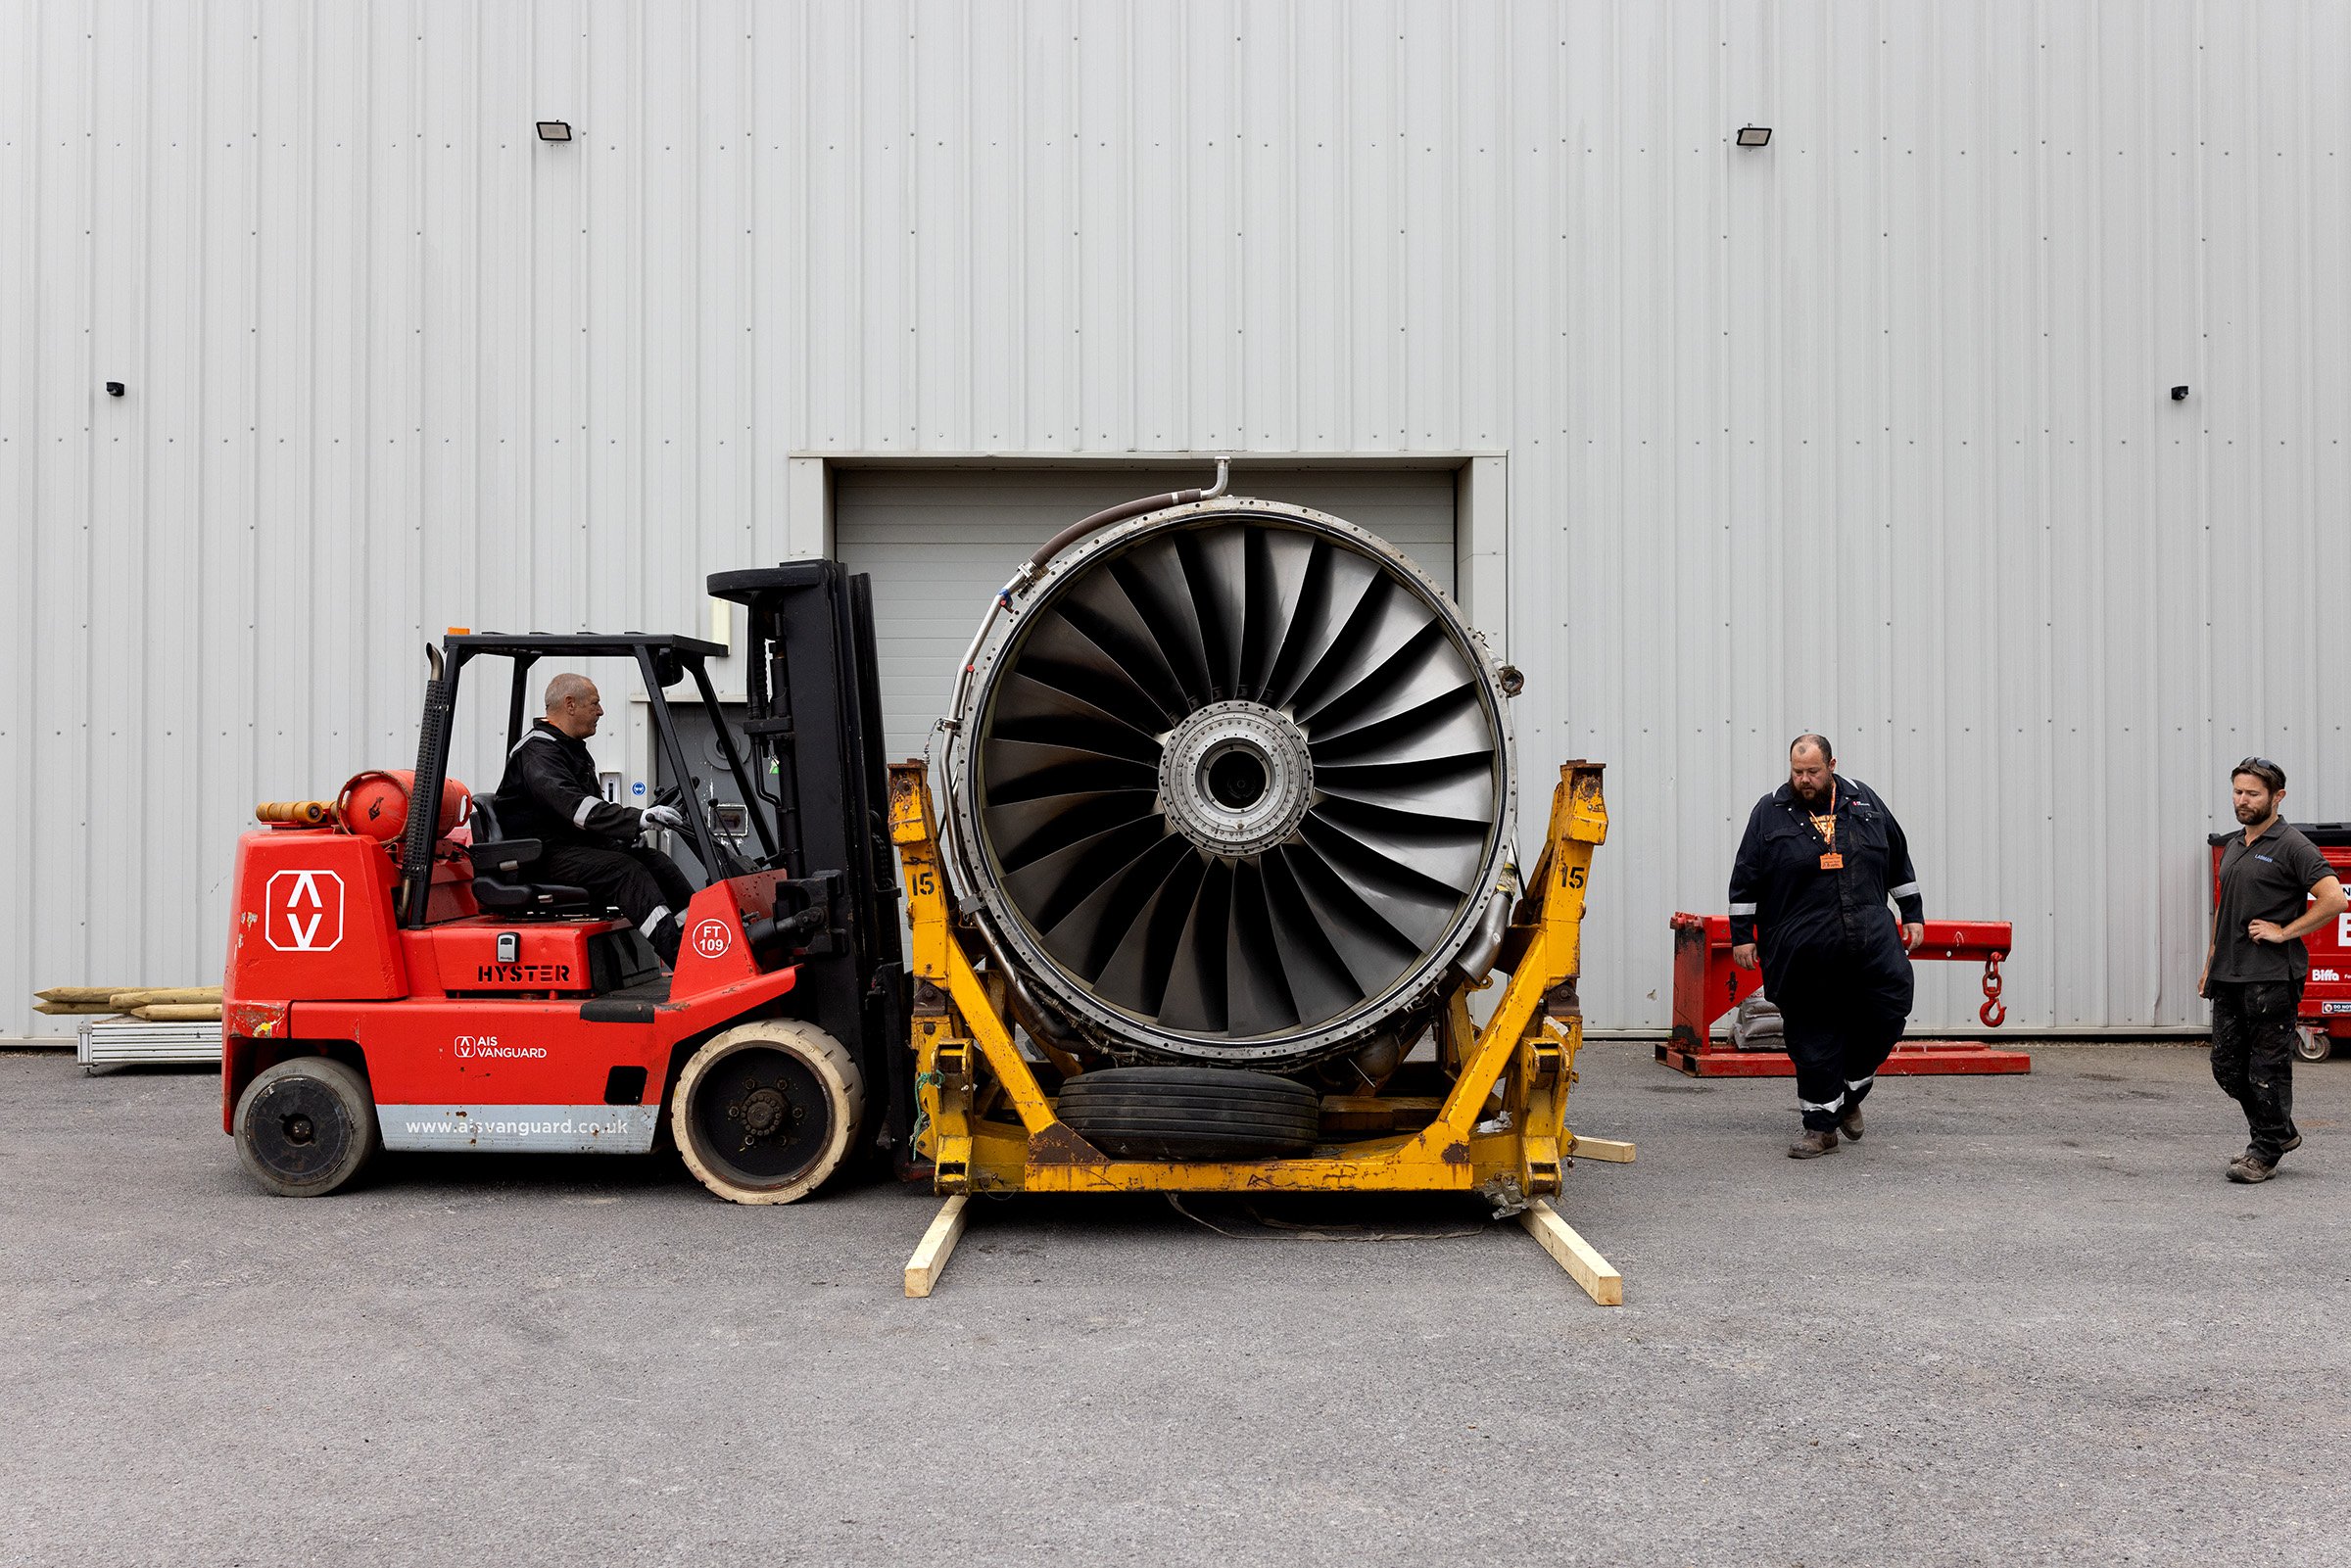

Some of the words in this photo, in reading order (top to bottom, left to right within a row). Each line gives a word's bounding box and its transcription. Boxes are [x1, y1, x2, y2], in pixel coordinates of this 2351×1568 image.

[912, 871, 935, 896] 15
[1560, 867, 1585, 889] 15
[703, 926, 722, 938] FT
[699, 938, 724, 951] 109
[477, 965, 570, 982] HYSTER
[2312, 969, 2340, 981] Biffa
[477, 1036, 498, 1047] AIS
[477, 1047, 548, 1059] VANGUARD
[406, 1118, 629, 1136] www.aisvanguard.co.uk
